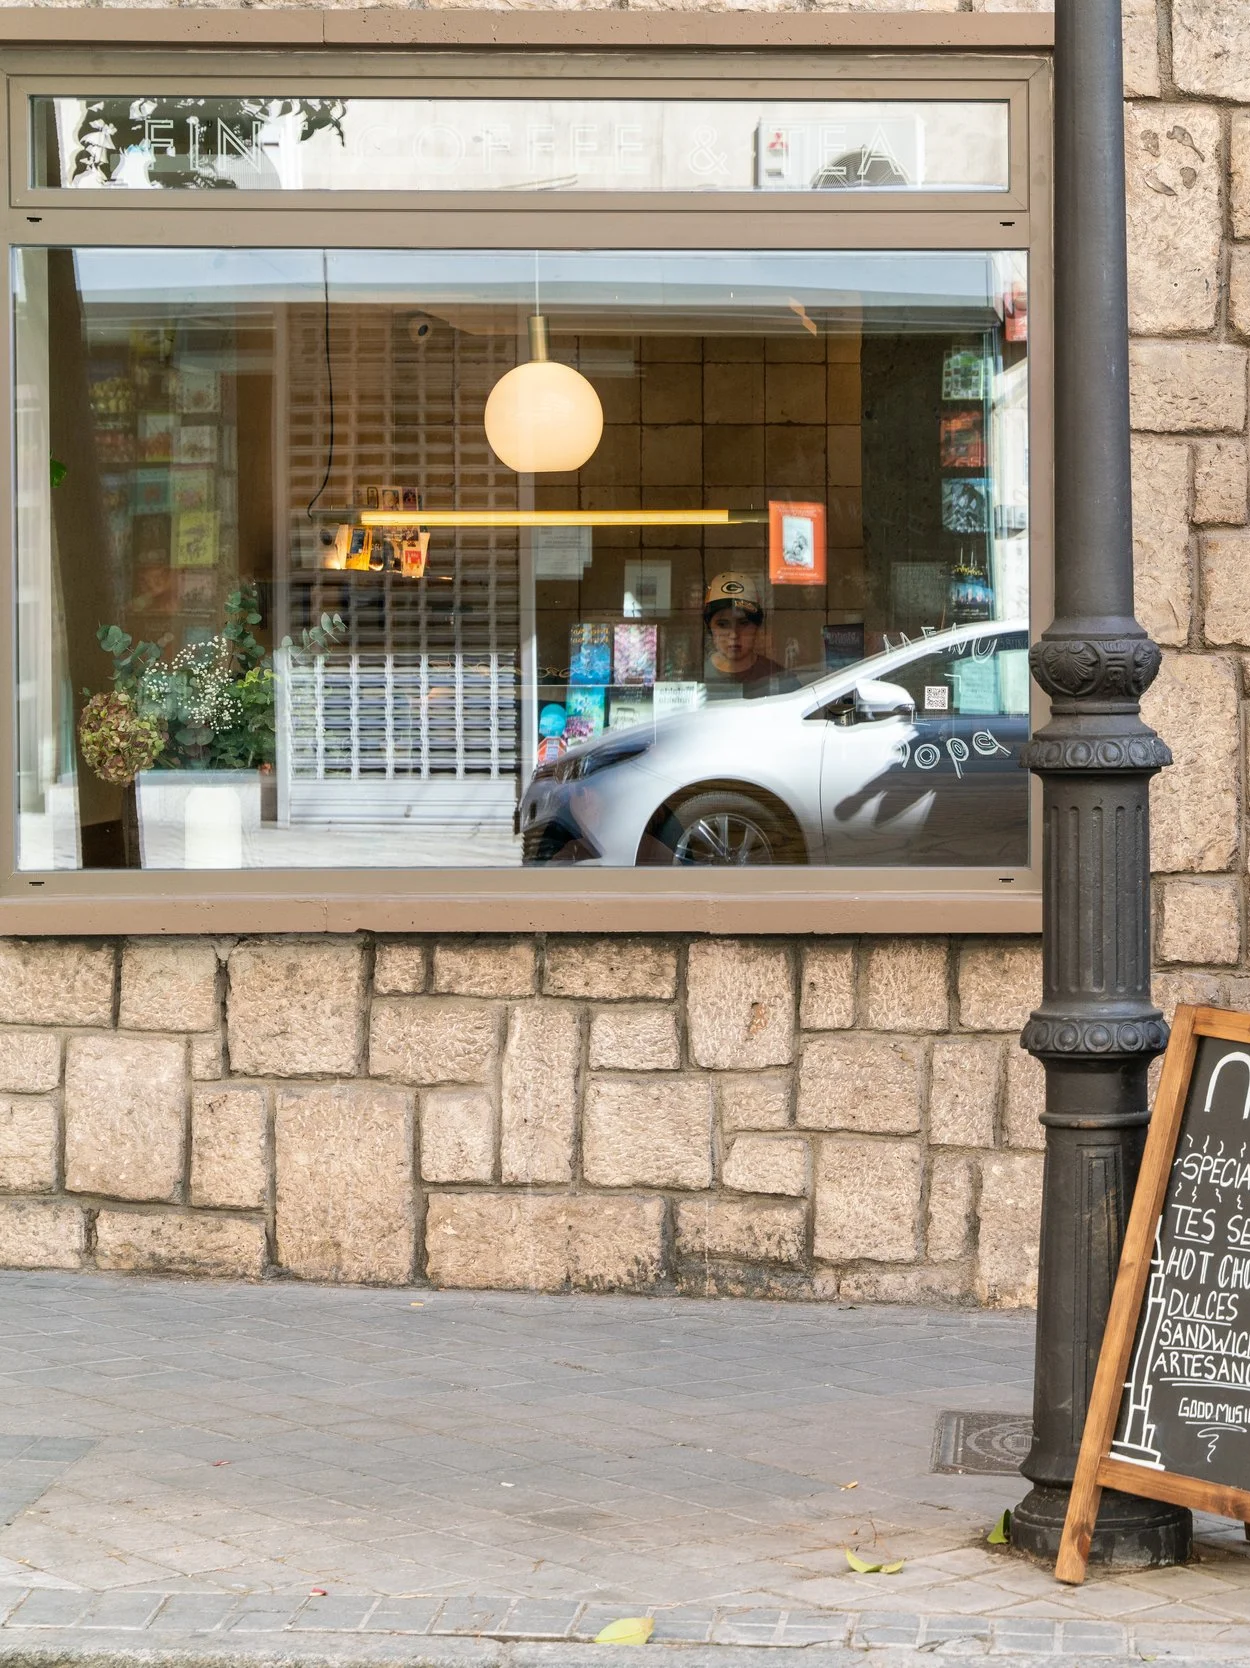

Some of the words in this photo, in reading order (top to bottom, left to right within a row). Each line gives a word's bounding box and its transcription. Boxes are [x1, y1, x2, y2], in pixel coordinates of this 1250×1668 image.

[145, 118, 306, 173] FIN
[354, 122, 644, 174] COFFEE
[687, 123, 732, 176] &
[769, 123, 902, 176] TEA
[1171, 1203, 1216, 1241] TES
[1165, 1245, 1210, 1285] HOT
[1166, 1290, 1239, 1322] DULCES
[1178, 1397, 1215, 1419] GOOD
